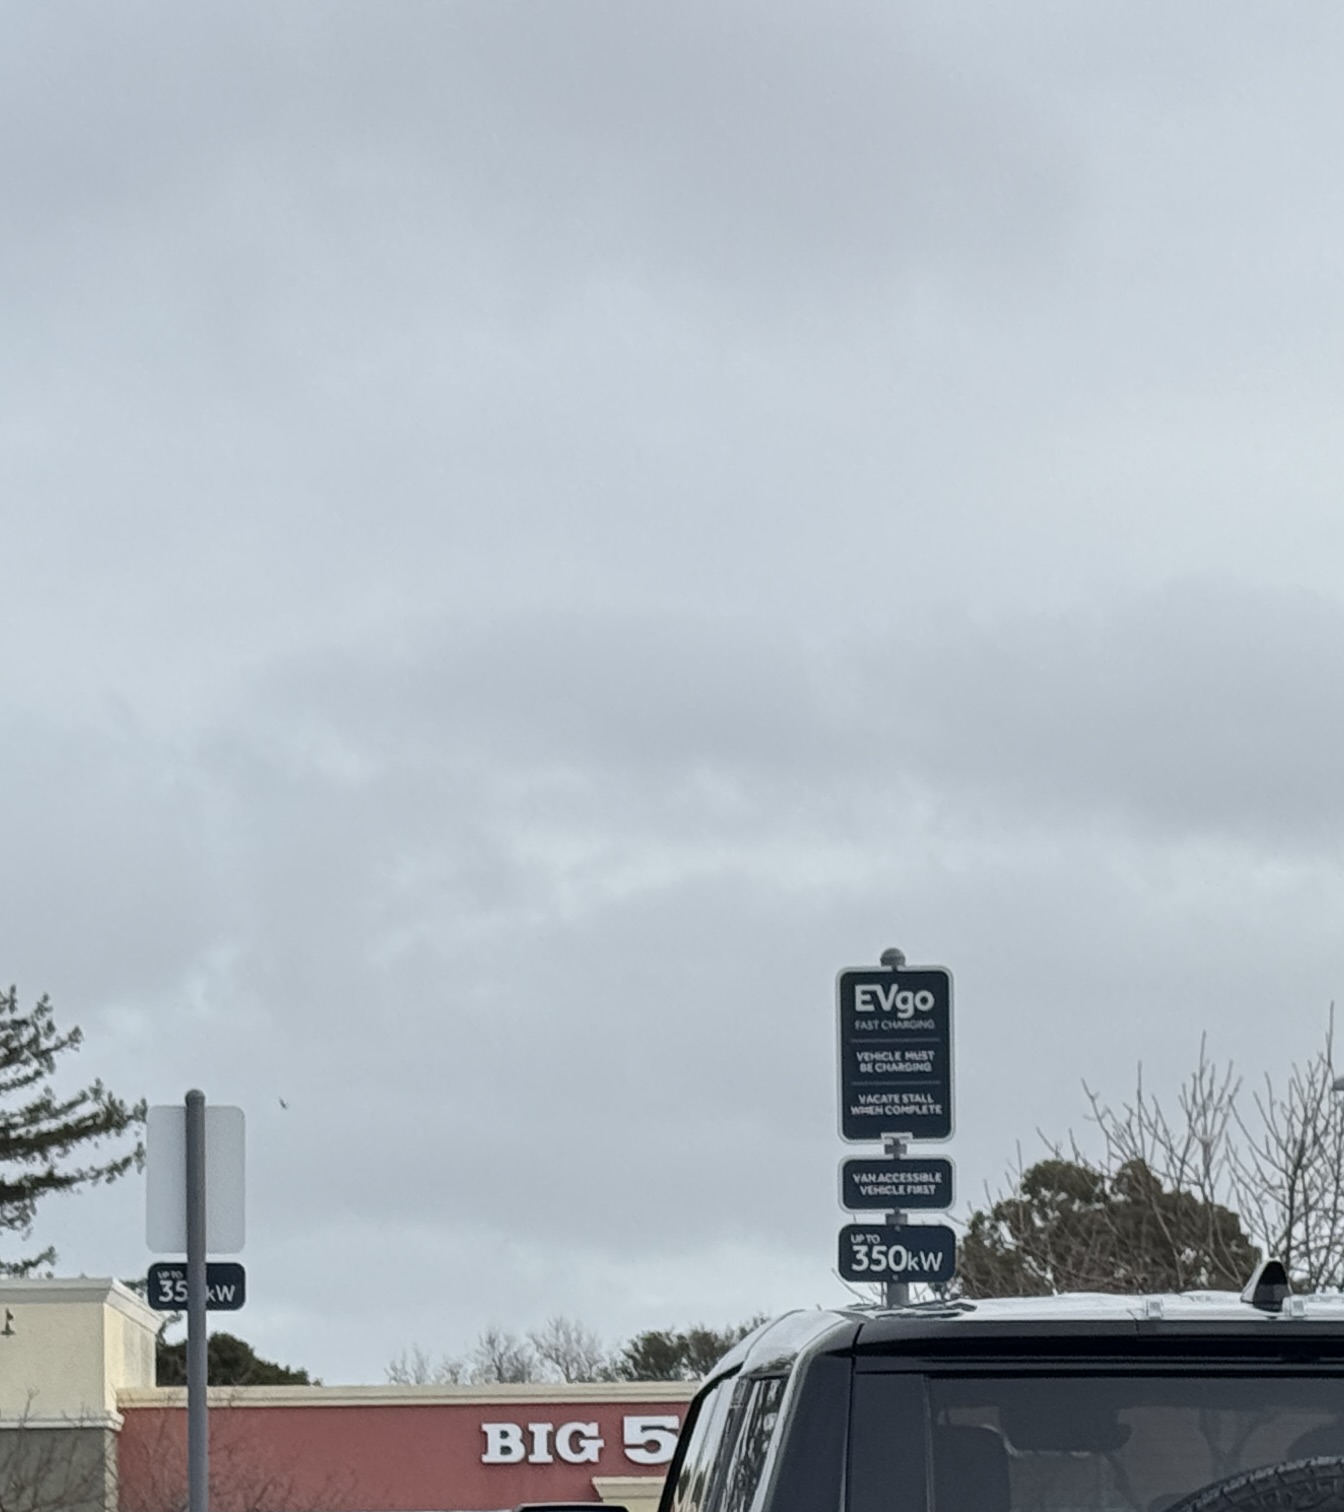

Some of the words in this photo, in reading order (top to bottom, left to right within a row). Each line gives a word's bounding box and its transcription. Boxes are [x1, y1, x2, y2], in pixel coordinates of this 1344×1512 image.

[854, 984, 935, 1019] EVgo
[854, 1021, 879, 1031] FAST
[881, 1019, 935, 1030] CHARGING
[856, 1051, 902, 1062] VEHICLE
[905, 1050, 935, 1061] MUST
[860, 1062, 873, 1073] BE
[874, 1062, 932, 1073] CHARGING
[858, 1094, 901, 1104] VACATE
[902, 1093, 934, 1103] STALL
[851, 1105, 883, 1115] WHEN
[885, 1104, 942, 1115] COMPLETE
[853, 1172, 876, 1184] VAN
[875, 1172, 942, 1184] ACCESSIBLE
[859, 1185, 905, 1196] VEHICLE
[907, 1184, 936, 1195] FIRST
[850, 1234, 864, 1244] UP
[865, 1234, 880, 1244] TO
[851, 1245, 943, 1272] 350kW
[158, 1280, 235, 1302] 35kW
[481, 1421, 605, 1464] BIG
[623, 1415, 680, 1465] 5
